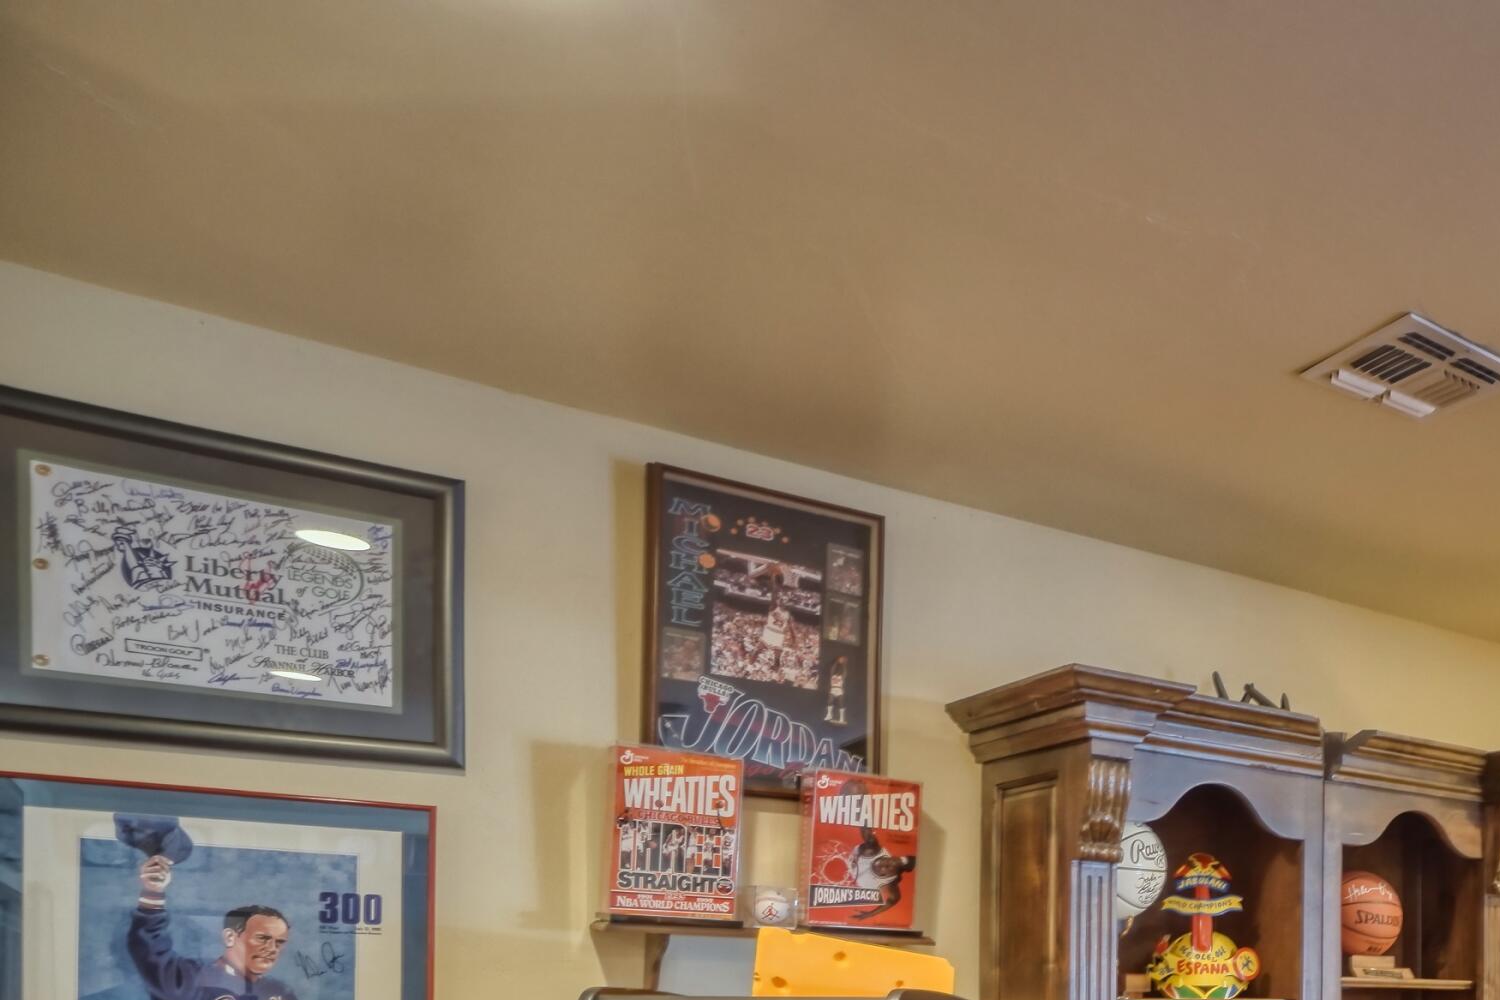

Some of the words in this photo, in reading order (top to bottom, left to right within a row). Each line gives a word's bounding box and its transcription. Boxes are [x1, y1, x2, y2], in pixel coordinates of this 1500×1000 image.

[184, 555, 283, 590] Liberty
[197, 600, 287, 621] INSURANCE
[274, 644, 297, 656] THE
[299, 647, 329, 659] CLUB
[659, 690, 863, 770] JORDAN
[624, 766, 654, 776] WHOLE
[657, 764, 684, 776] GRAIN
[624, 774, 737, 818] WHEATIES
[819, 792, 915, 832] WHEATIES
[617, 870, 718, 894] STRAIGHT
[616, 895, 639, 908] NBA
[639, 899, 673, 910] WORLD
[674, 901, 730, 913] CHAMPIONS
[814, 885, 853, 906] JORDAN'S
[319, 892, 382, 925] 300
[1354, 910, 1400, 926] SPALD
